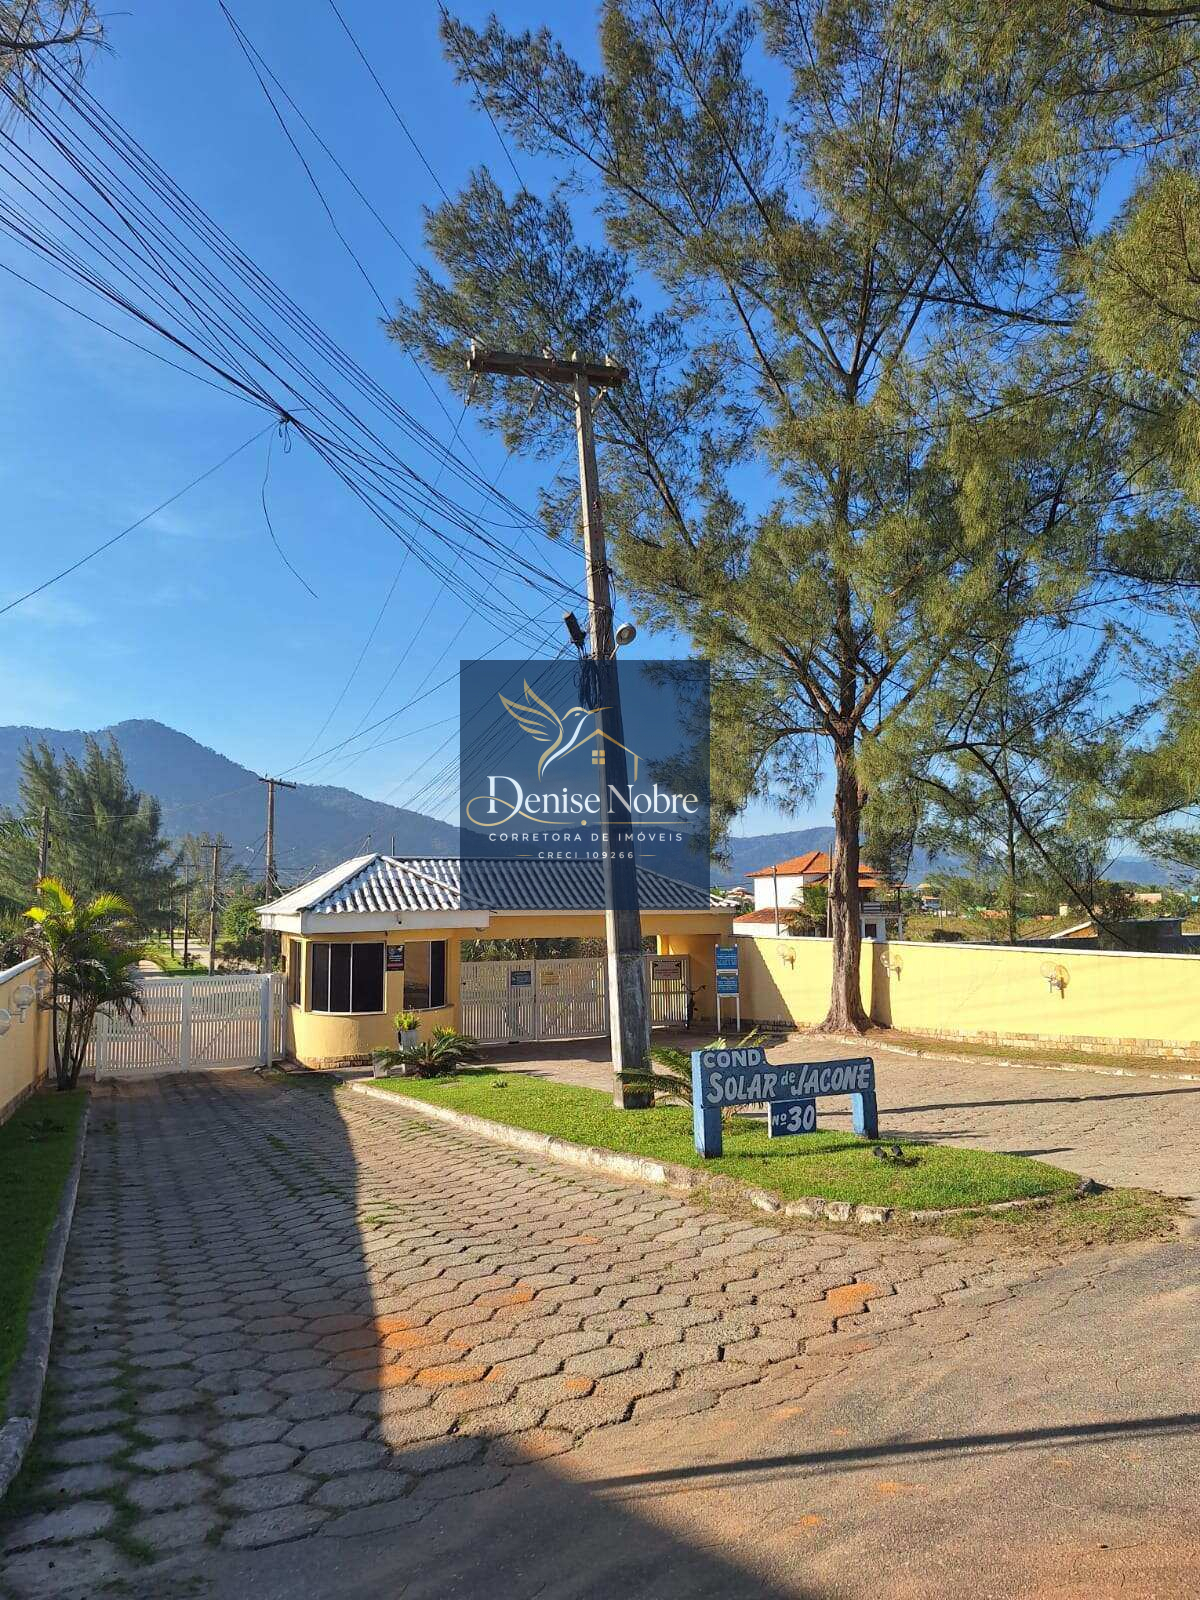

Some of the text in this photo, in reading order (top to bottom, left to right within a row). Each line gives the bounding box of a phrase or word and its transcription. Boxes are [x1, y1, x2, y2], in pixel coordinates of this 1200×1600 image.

[703, 1050, 767, 1068] COND.
[706, 1071, 778, 1104] SOLAR
[780, 1070, 796, 1086] de
[787, 1104, 815, 1132] 30
